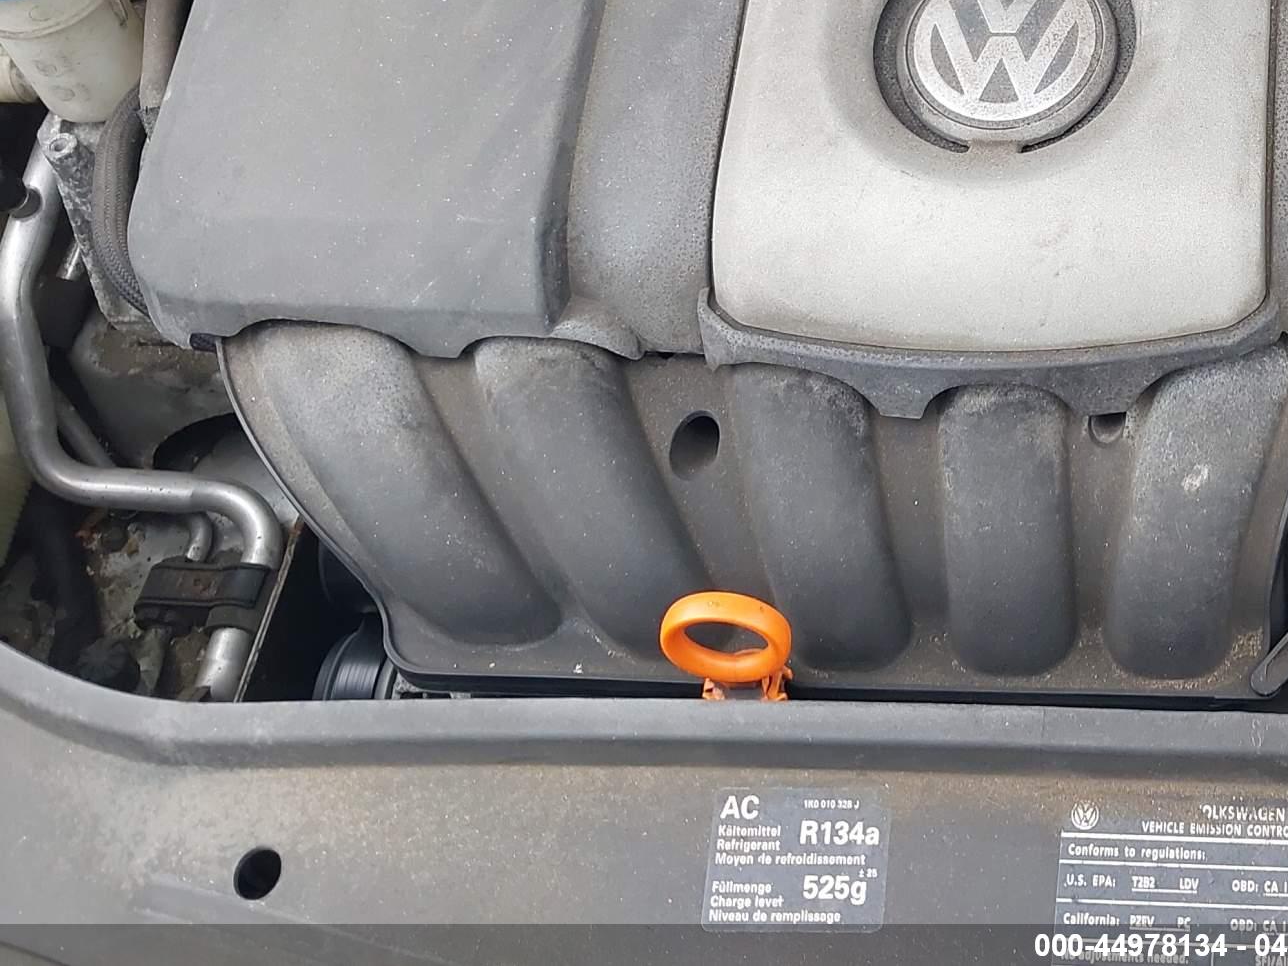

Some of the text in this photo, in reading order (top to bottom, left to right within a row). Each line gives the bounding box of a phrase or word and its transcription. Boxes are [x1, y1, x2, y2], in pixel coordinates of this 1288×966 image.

[719, 795, 760, 819] AC
[1200, 804, 1286, 822] OLKSWAGEN
[800, 820, 880, 846] R134a
[1142, 821, 1184, 834] VEHICLE
[1190, 822, 1242, 836] EMISSION
[717, 839, 781, 853] Refrigerant
[1068, 844, 1119, 857] Conforms
[1124, 846, 1136, 857] to
[803, 875, 868, 906] 525g
[1066, 874, 1087, 886] U.S.
[1179, 878, 1199, 890] LDV
[1264, 881, 1278, 893] CA
[710, 896, 751, 909] Charge
[709, 910, 749, 922] Niveau
[1063, 913, 1120, 926] California:
